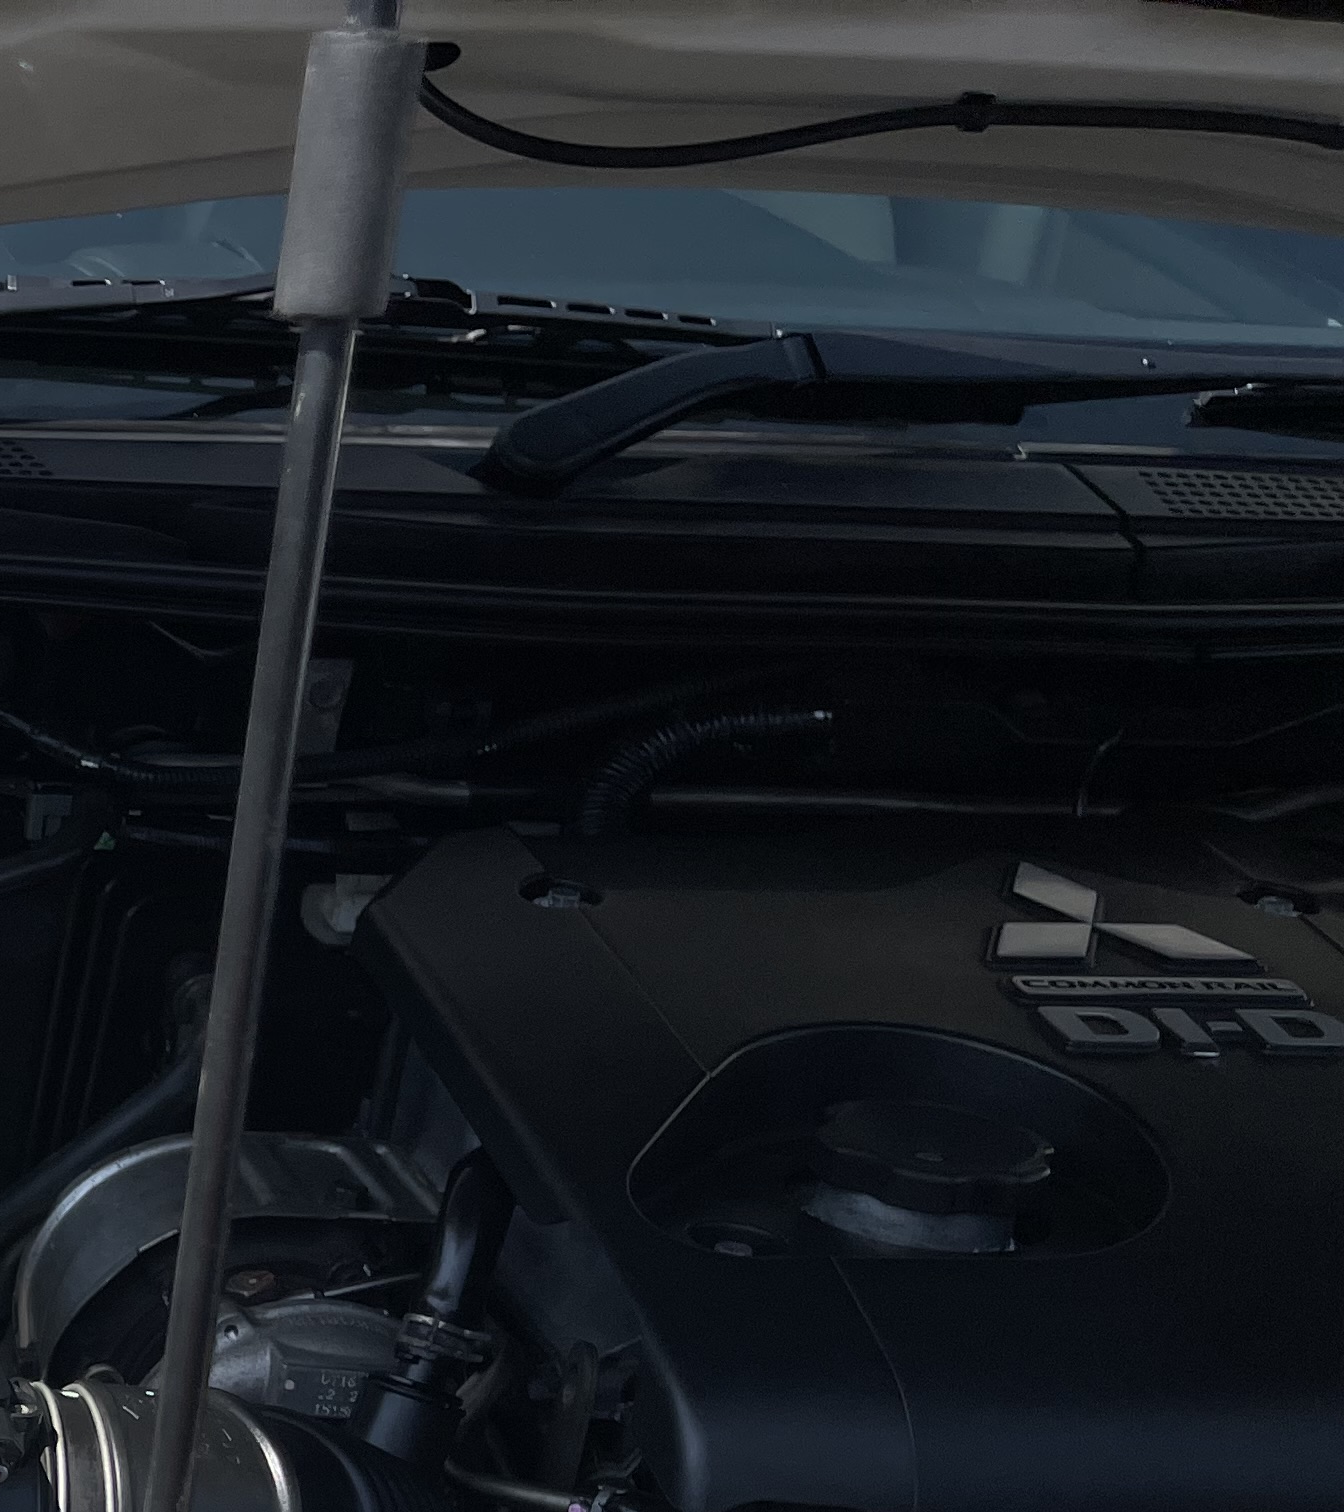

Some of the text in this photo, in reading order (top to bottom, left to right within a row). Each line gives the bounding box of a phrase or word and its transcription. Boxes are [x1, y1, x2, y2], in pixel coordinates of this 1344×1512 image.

[1021, 978, 1298, 992] COMMON RAIL
[1037, 1005, 1344, 1052] DI-D
